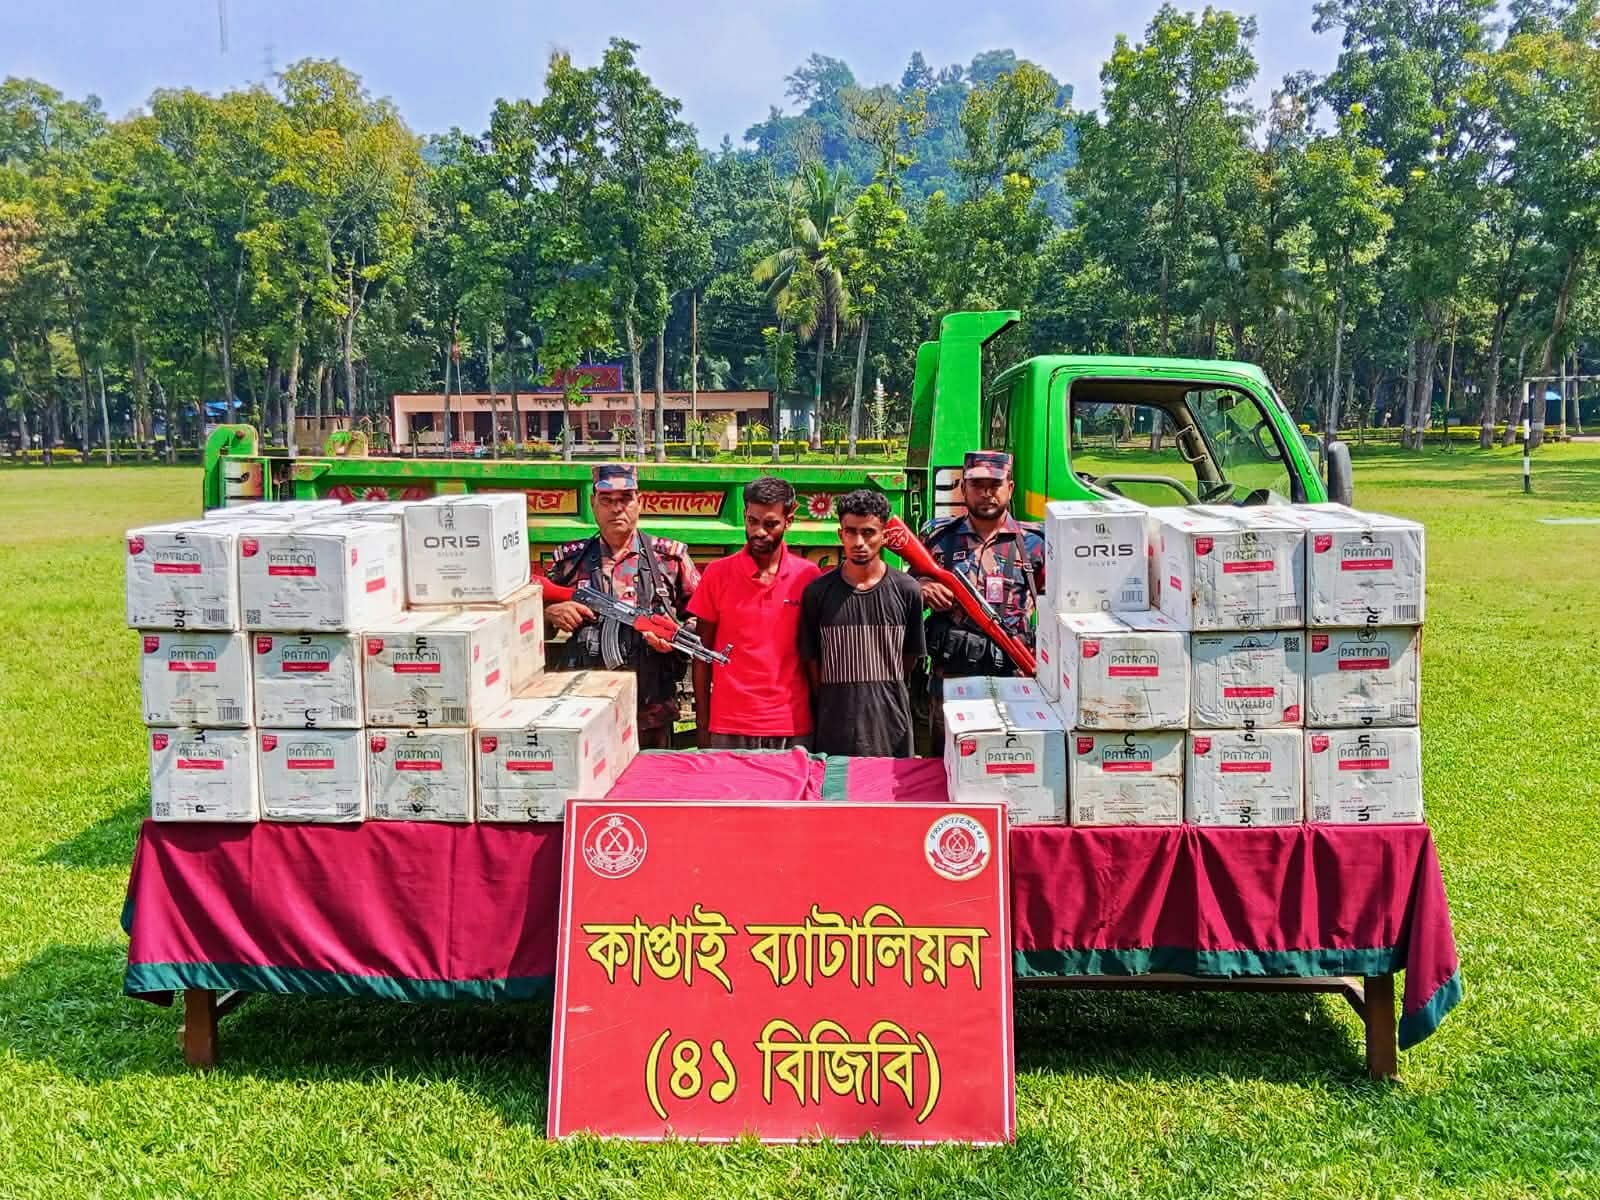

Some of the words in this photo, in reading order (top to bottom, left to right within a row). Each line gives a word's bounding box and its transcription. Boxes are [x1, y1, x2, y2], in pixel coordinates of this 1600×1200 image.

[637, 493, 723, 513] াংলাদেশ
[424, 535, 481, 549] ORIS
[1074, 543, 1134, 558] ORIS
[1343, 547, 1391, 558] PATRON
[268, 553, 315, 565] PATRON
[169, 650, 216, 661] PATRON
[283, 650, 329, 662] PATRON
[1340, 647, 1387, 658] PATRON
[1111, 654, 1157, 665] PATRON
[288, 747, 334, 758] PATRON
[397, 750, 442, 761] PATRON
[508, 749, 552, 760] PATRON
[987, 752, 1033, 763] PATRON
[582, 904, 736, 992] কাপ্তাই
[746, 904, 989, 990] ব্যাটালিয়ন
[645, 1028, 739, 1121] (৪১
[755, 1018, 942, 1123] বিজিবি)
